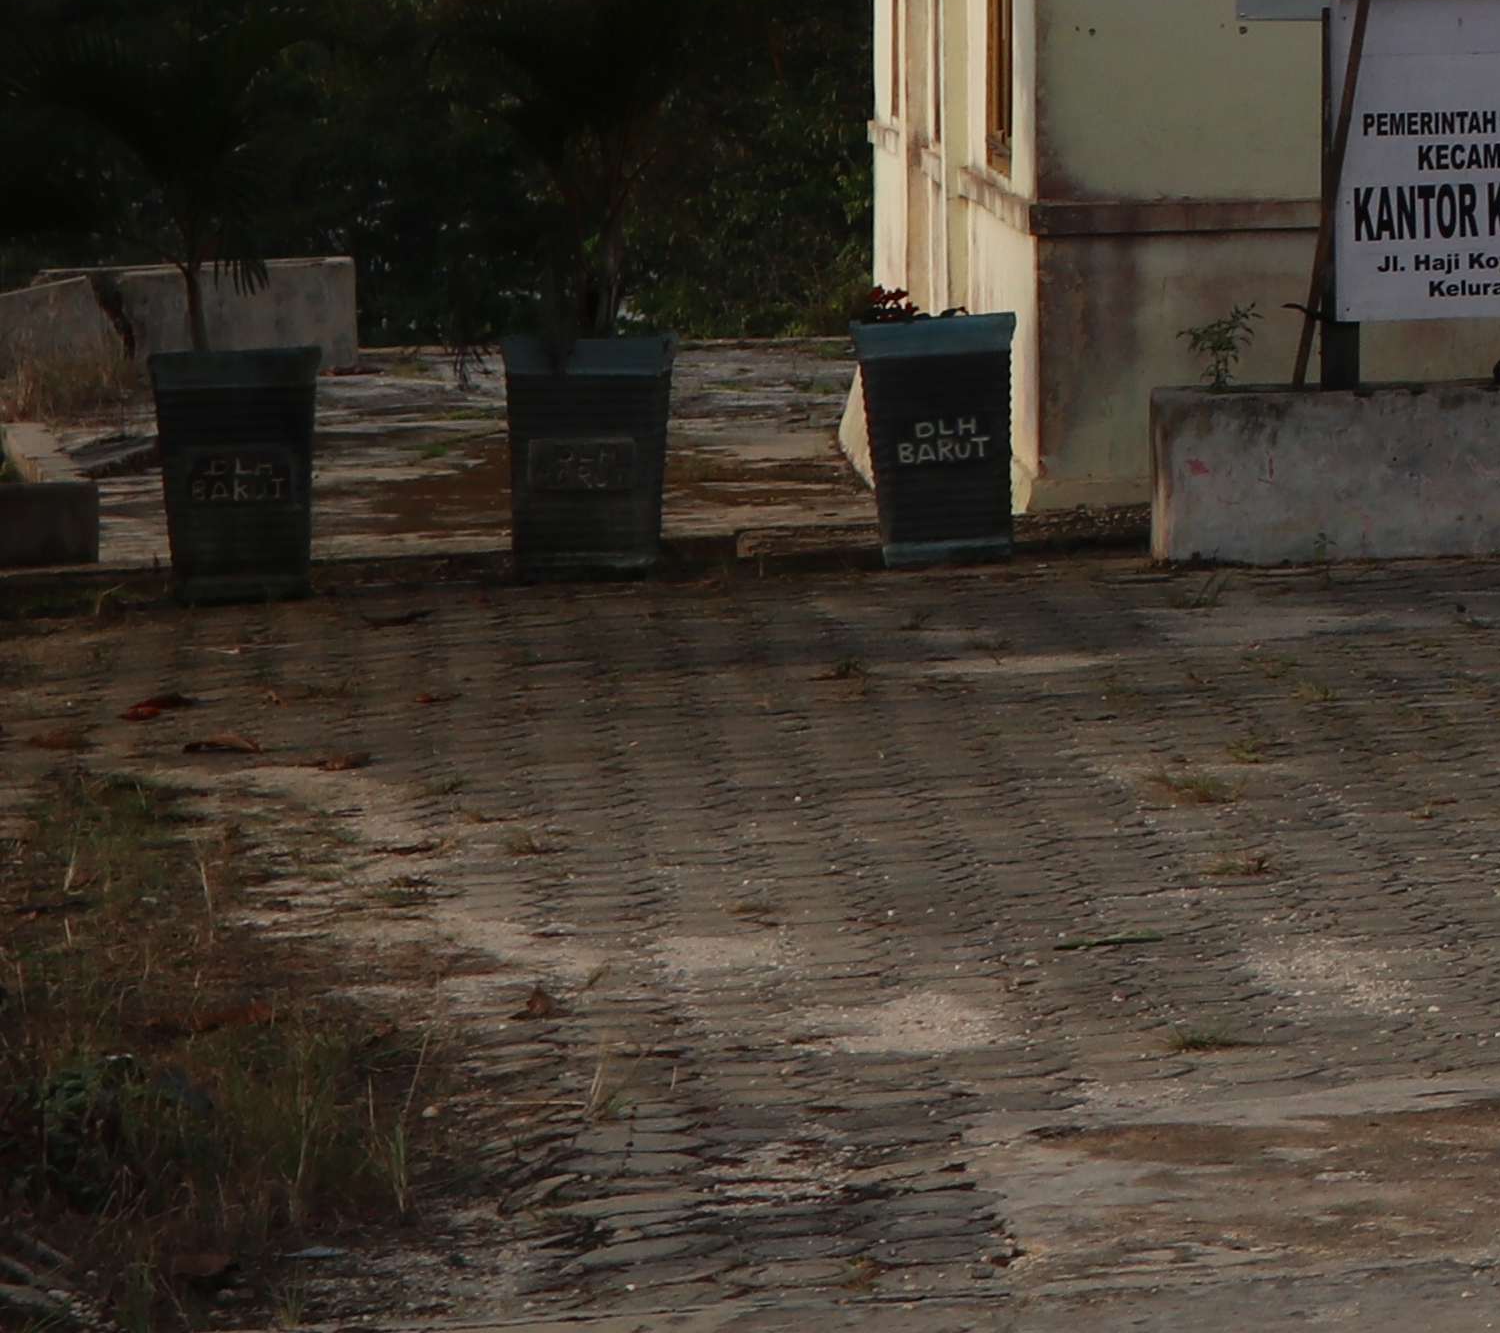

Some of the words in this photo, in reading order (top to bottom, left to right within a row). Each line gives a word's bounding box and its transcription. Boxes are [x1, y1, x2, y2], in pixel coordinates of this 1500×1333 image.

[1363, 111, 1497, 136] PEMERINTAH
[1354, 183, 1479, 242] KANTOR
[1414, 253, 1460, 275] Haji
[914, 415, 977, 439] DLH
[897, 435, 991, 465] BARUT
